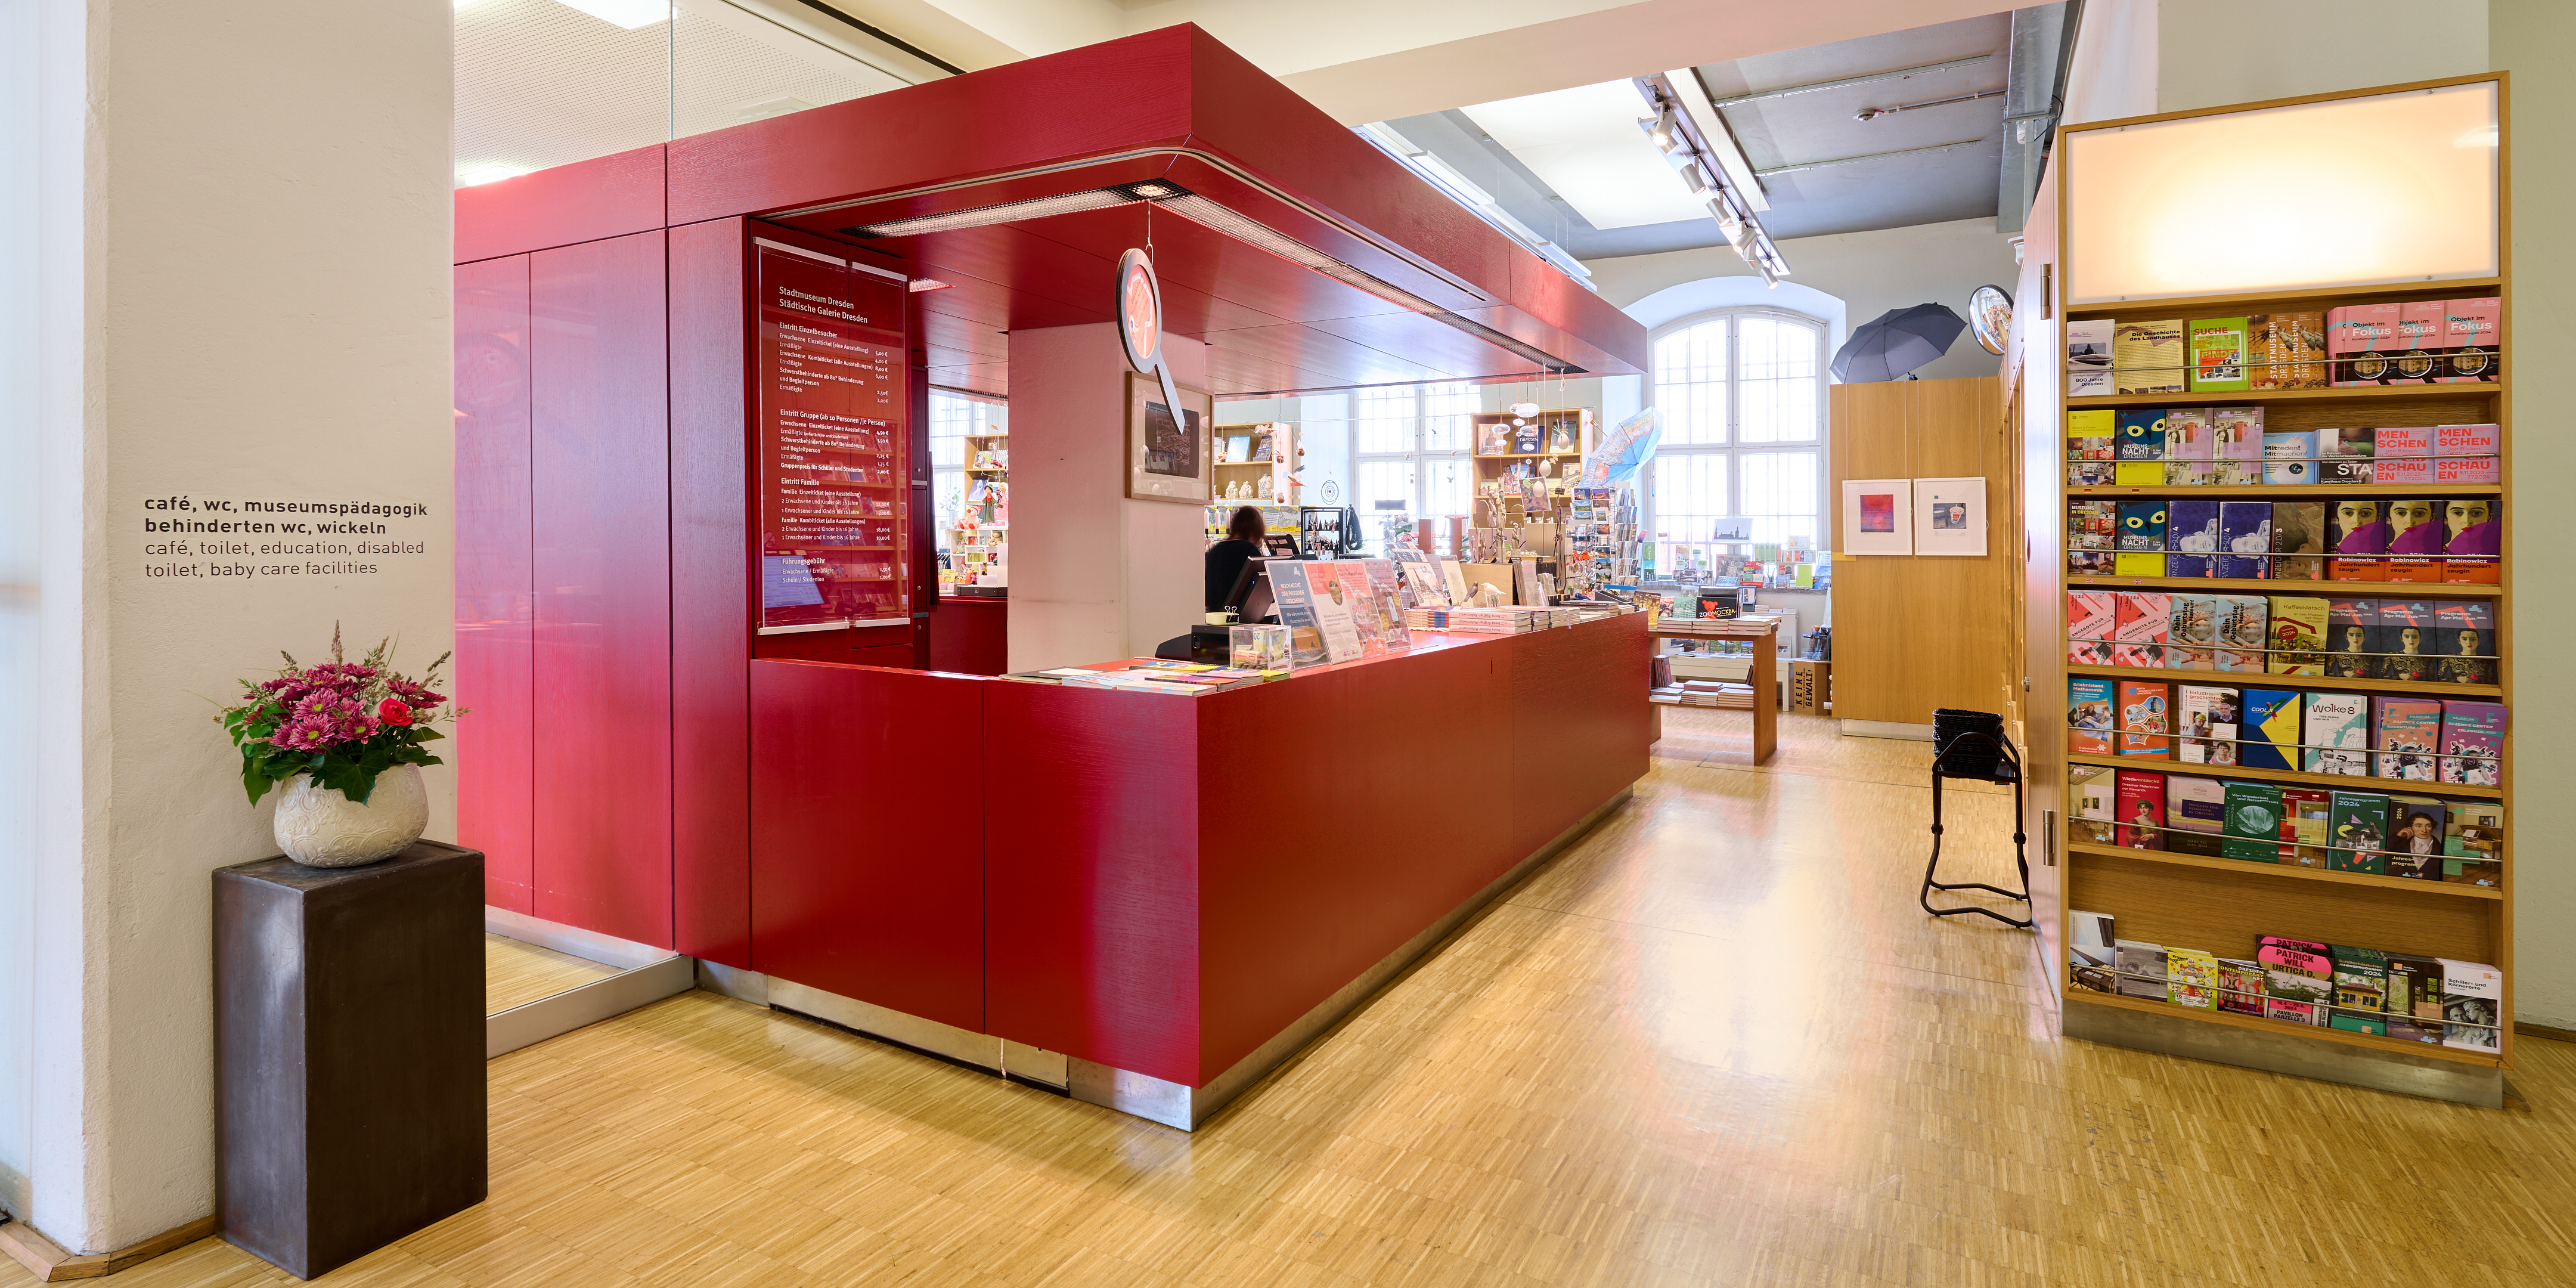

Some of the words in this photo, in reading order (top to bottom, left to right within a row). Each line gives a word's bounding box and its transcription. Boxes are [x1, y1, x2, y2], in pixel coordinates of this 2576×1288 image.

[779, 286, 826, 304] Stadtmuseum
[828, 297, 854, 309] Dresden
[779, 299, 816, 312] Städtische
[817, 307, 841, 317] Galerie
[842, 311, 867, 323] Dresden
[779, 323, 798, 331] Eintritt
[799, 326, 837, 338] Einzelbesucher
[2194, 327, 2228, 335] SUCHE
[2451, 321, 2492, 331] Fokus
[779, 333, 805, 342] Erwachsene
[808, 338, 832, 347] Einzelticket
[844, 345, 868, 354] Ausstellung)
[779, 342, 802, 350] Ermäßigte
[779, 350, 805, 359] Erwachsene
[808, 355, 833, 363] Kombiticket
[844, 361, 873, 370] Ausstellungen)
[780, 367, 823, 378] Schwerstbehinderte
[838, 376, 864, 385] Behinderung
[789, 377, 819, 386] Begleitperson
[800, 411, 819, 420] Gruppe
[2439, 428, 2472, 436] MEN
[2439, 437, 2491, 446] SCHEN
[2338, 463, 2373, 475] STA
[2438, 461, 2490, 470] SCHAU
[2438, 471, 2457, 479] EN
[144, 496, 197, 513] café,
[203, 500, 238, 513] wc,
[244, 500, 427, 518] museumspädagogik
[145, 519, 275, 533] behinderten
[281, 524, 312, 535] wc,
[317, 521, 386, 534] wickeln
[145, 540, 193, 556] café,
[200, 541, 255, 556] toilet,
[260, 541, 351, 556] education,
[357, 541, 424, 554] disabled
[145, 564, 203, 578] toilet,
[210, 563, 255, 578] baby
[261, 564, 300, 575] care
[306, 562, 377, 575] facilities
[2181, 602, 2189, 637] Geburtstag
[2312, 704, 2346, 713] Wolke
[2276, 949, 2314, 963] PATRICK
[2284, 958, 2305, 968] WILL
[2338, 962, 2383, 972] JAHRESPROGRAMM
[2339, 959, 2383, 968] Schillerhäuschen
[2217, 965, 2264, 978] CONTEMPORARY
[2238, 966, 2264, 974] DRESDEN
[2273, 964, 2304, 976] URTICA
